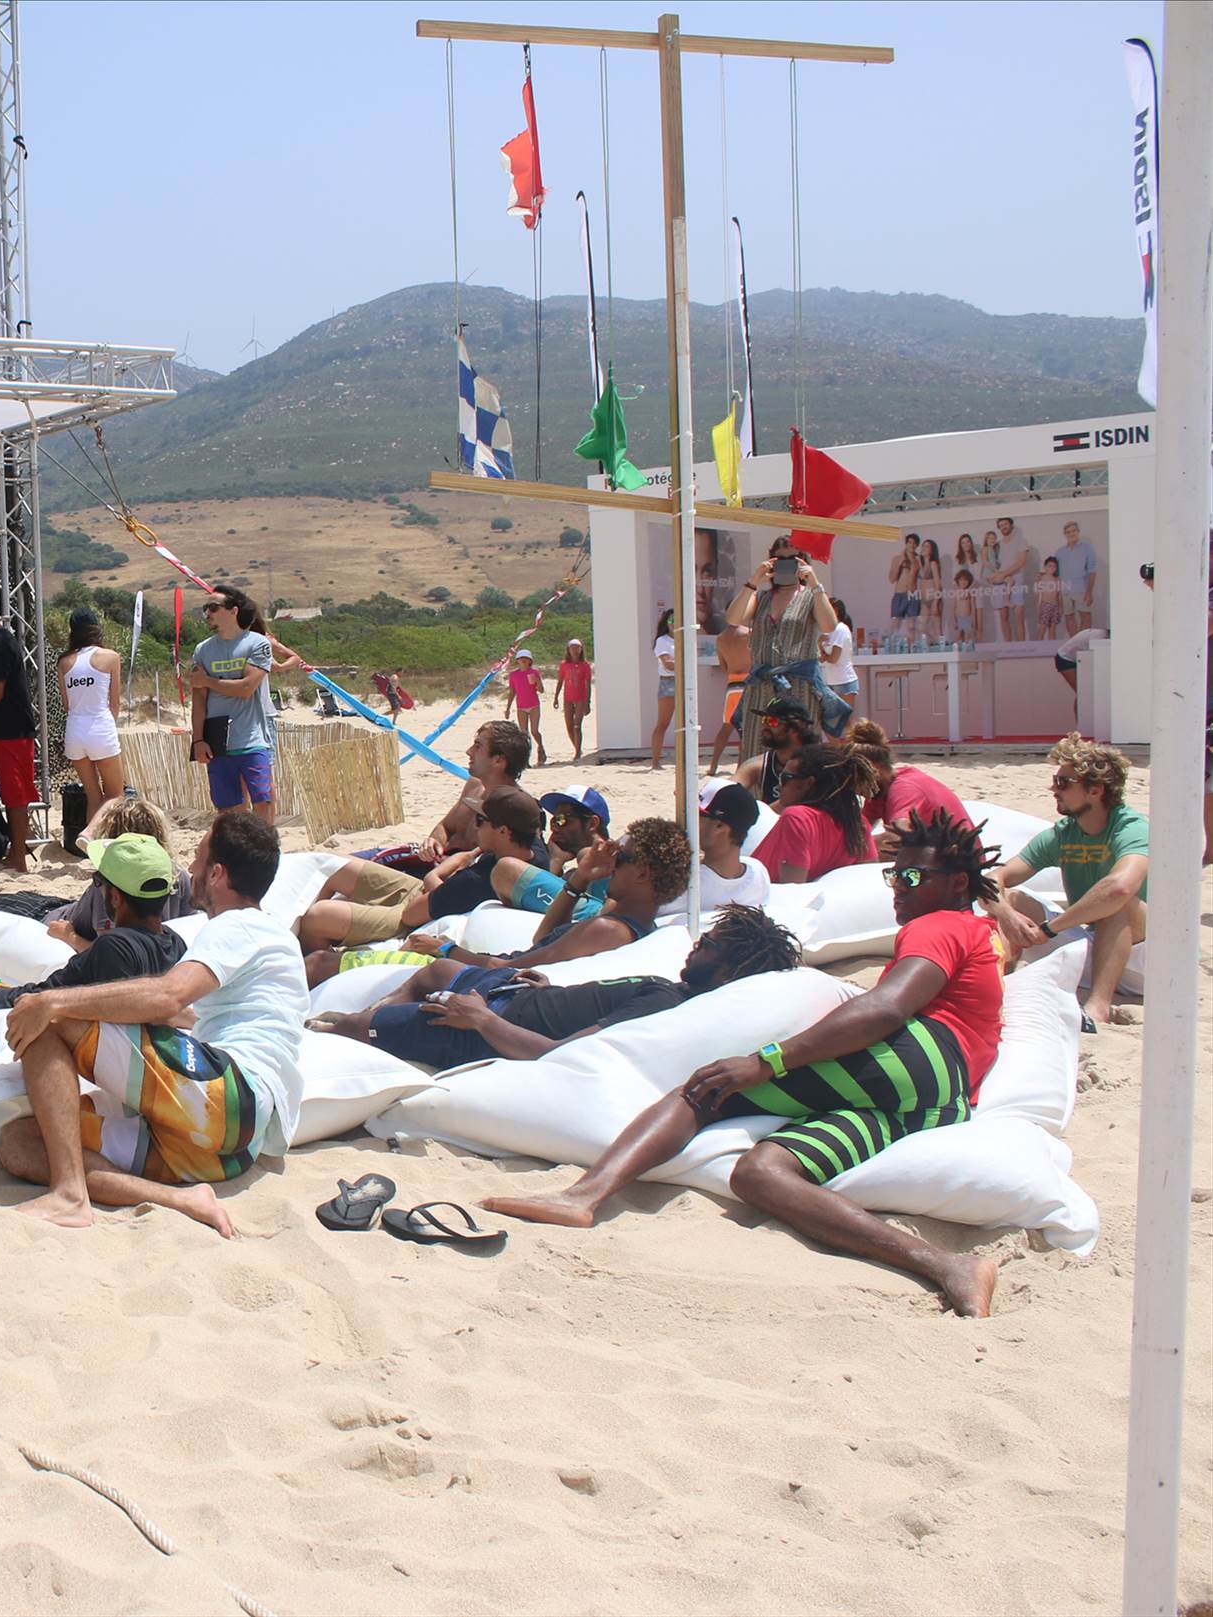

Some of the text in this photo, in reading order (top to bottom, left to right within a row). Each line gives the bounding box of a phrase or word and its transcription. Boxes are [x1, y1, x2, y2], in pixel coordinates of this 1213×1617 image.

[1095, 425, 1149, 448] ISDIN
[1034, 579, 1072, 593] ISDIN
[67, 672, 95, 689] Jeep
